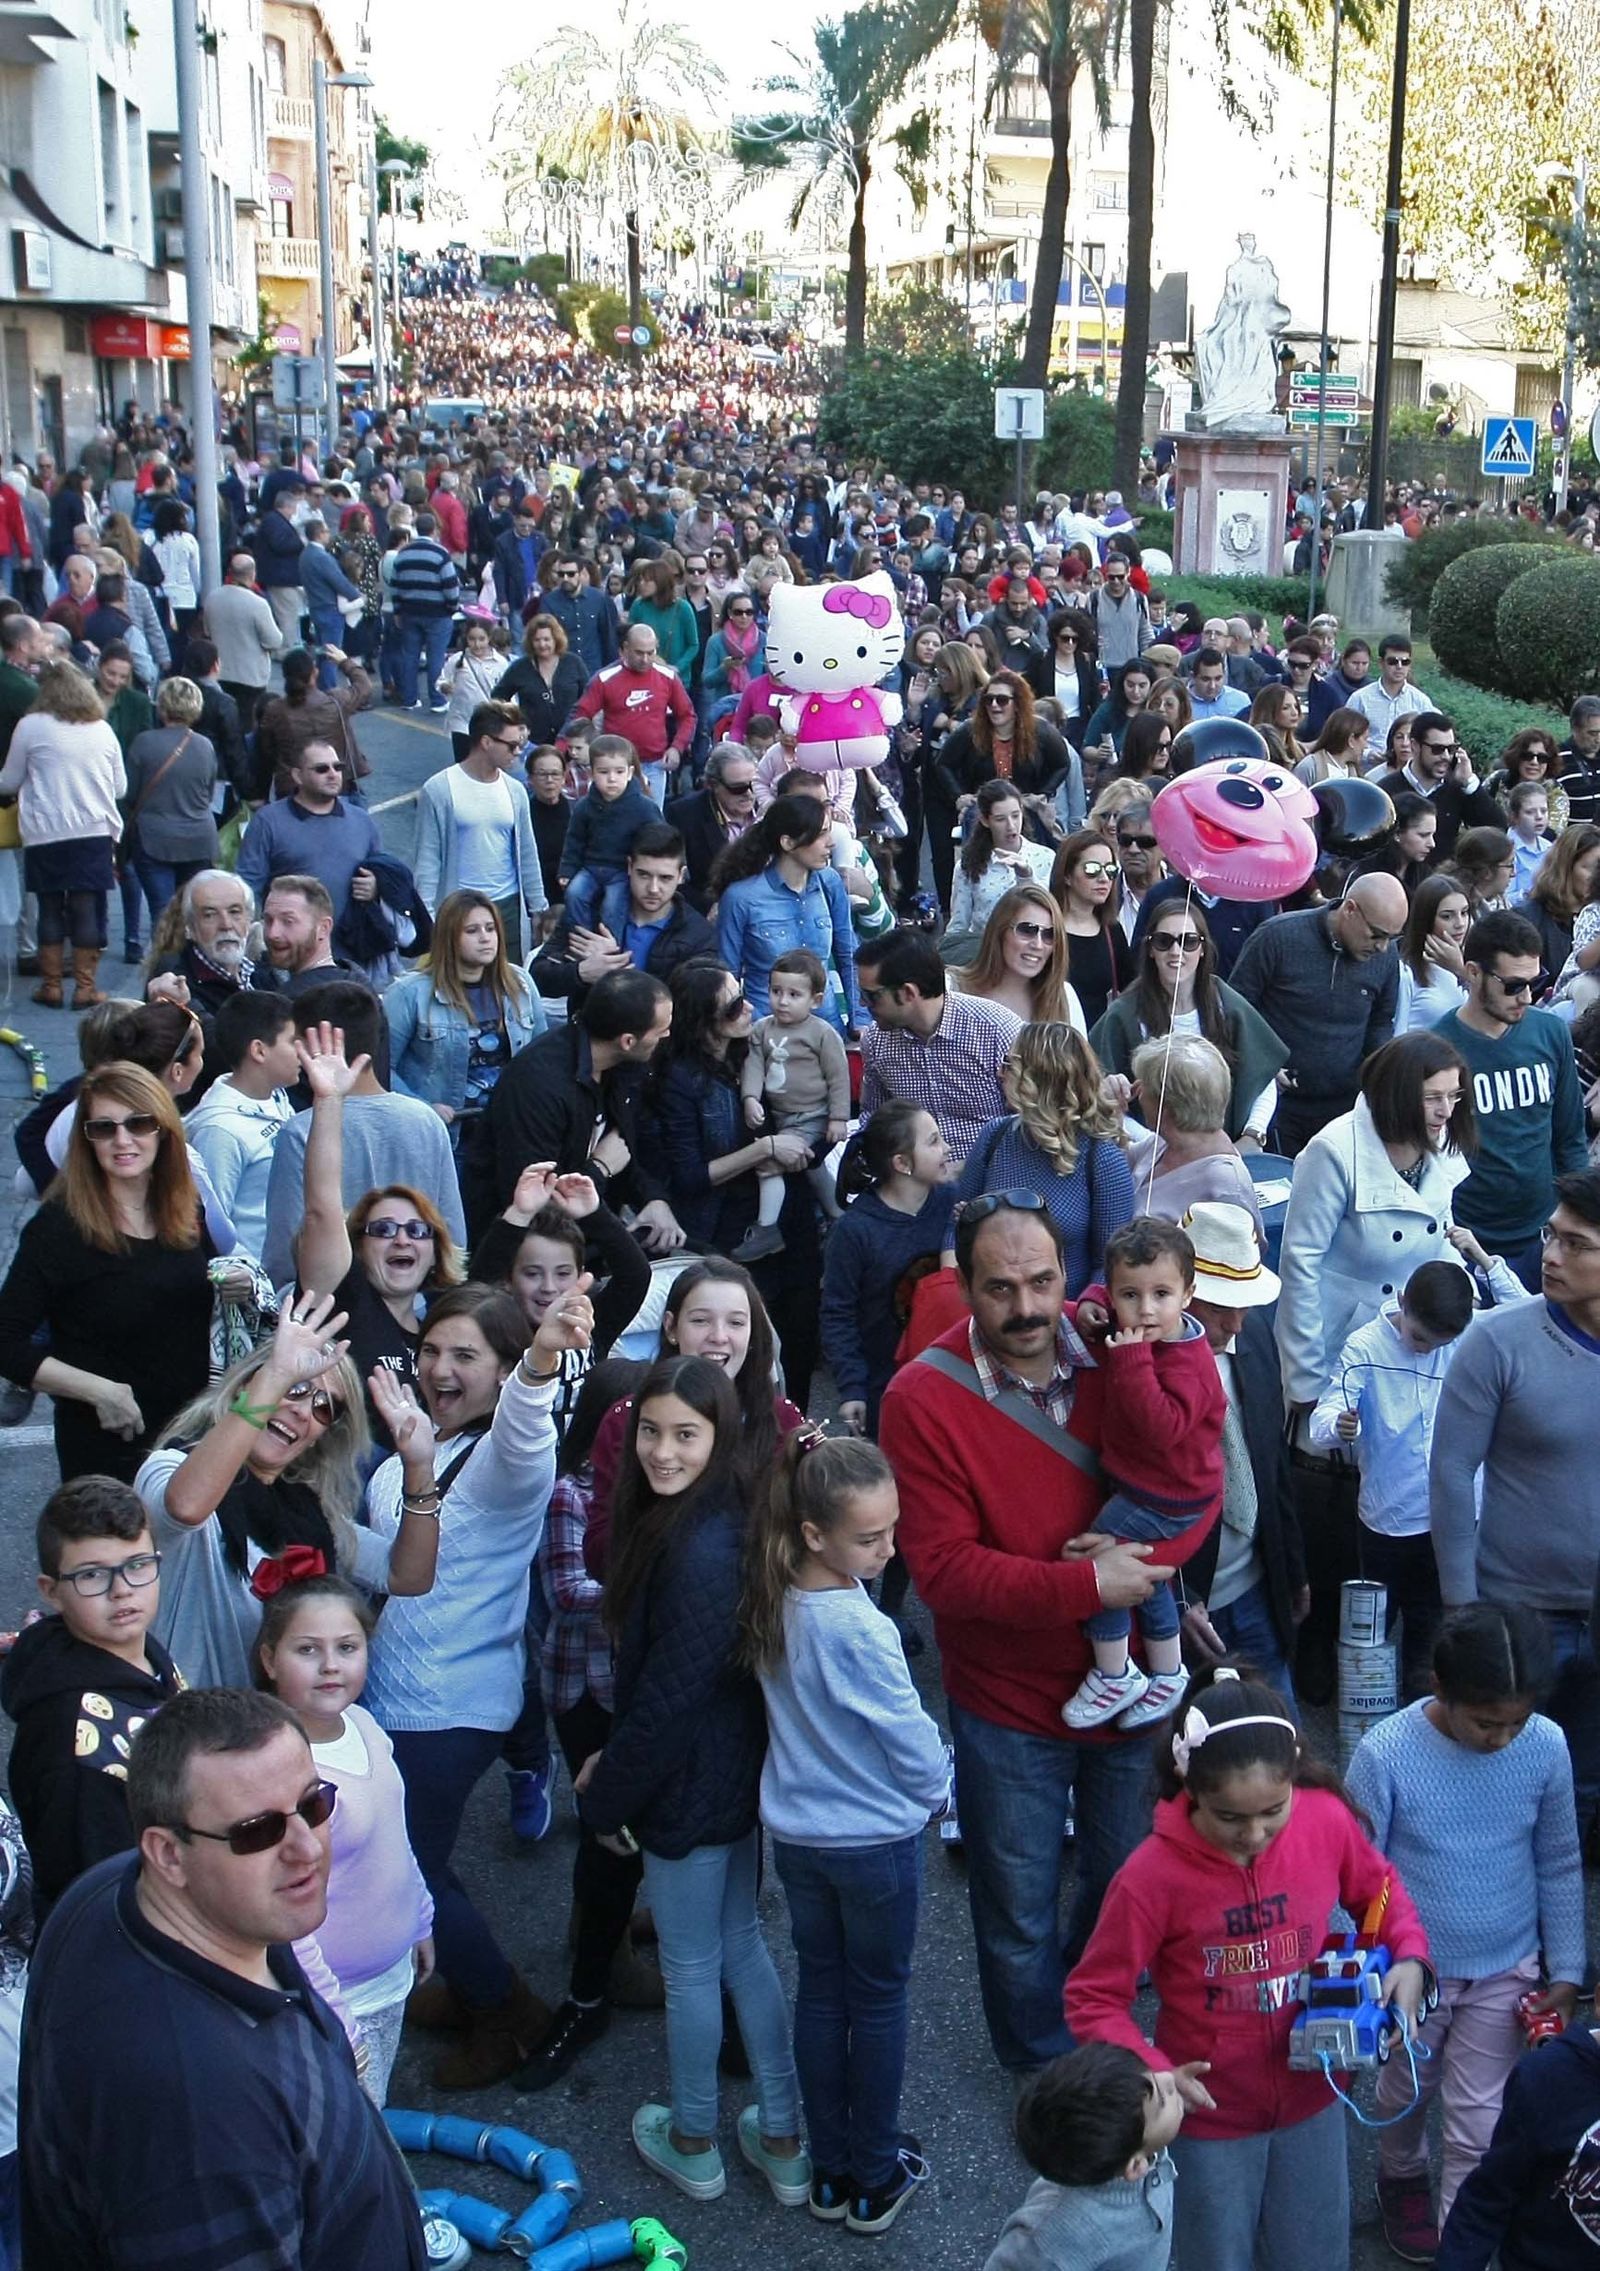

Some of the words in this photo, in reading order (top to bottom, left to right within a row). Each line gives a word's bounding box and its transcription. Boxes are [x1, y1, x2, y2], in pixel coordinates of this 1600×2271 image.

[1473, 1063, 1552, 1115] ONDN
[378, 1356, 404, 1371] THE
[1224, 1893, 1288, 1938] BEST
[1204, 1970, 1301, 2013] FOREVE
